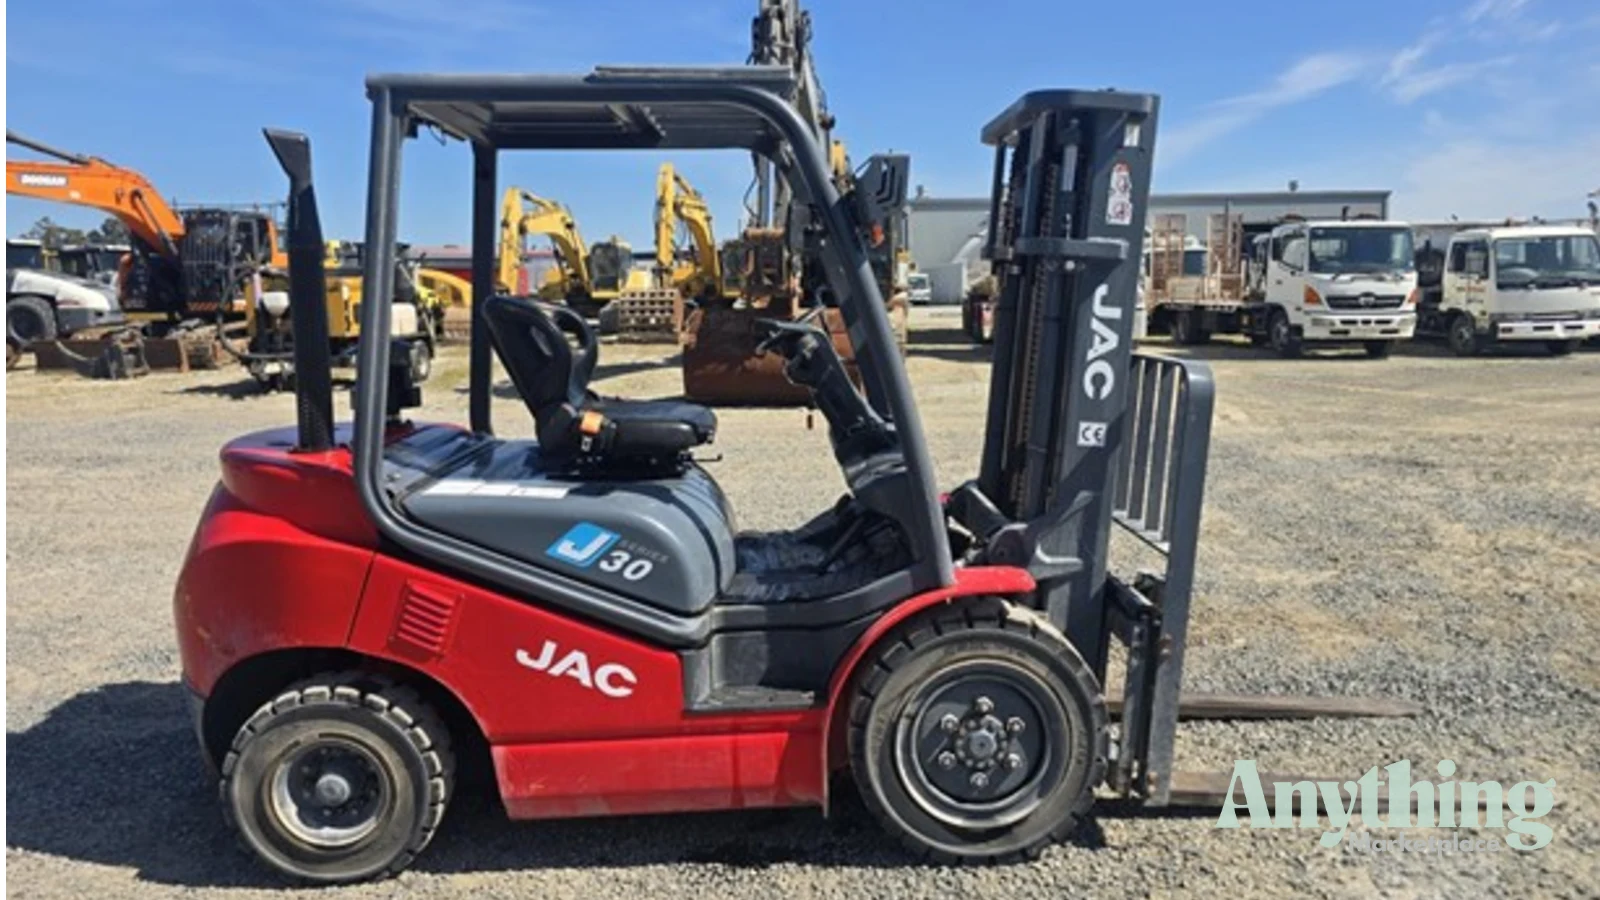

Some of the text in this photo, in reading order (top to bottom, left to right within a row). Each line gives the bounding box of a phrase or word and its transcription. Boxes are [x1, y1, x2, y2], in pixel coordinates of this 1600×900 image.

[1083, 283, 1122, 400] JAC
[557, 532, 653, 580] J 30
[515, 639, 638, 698] JAC
